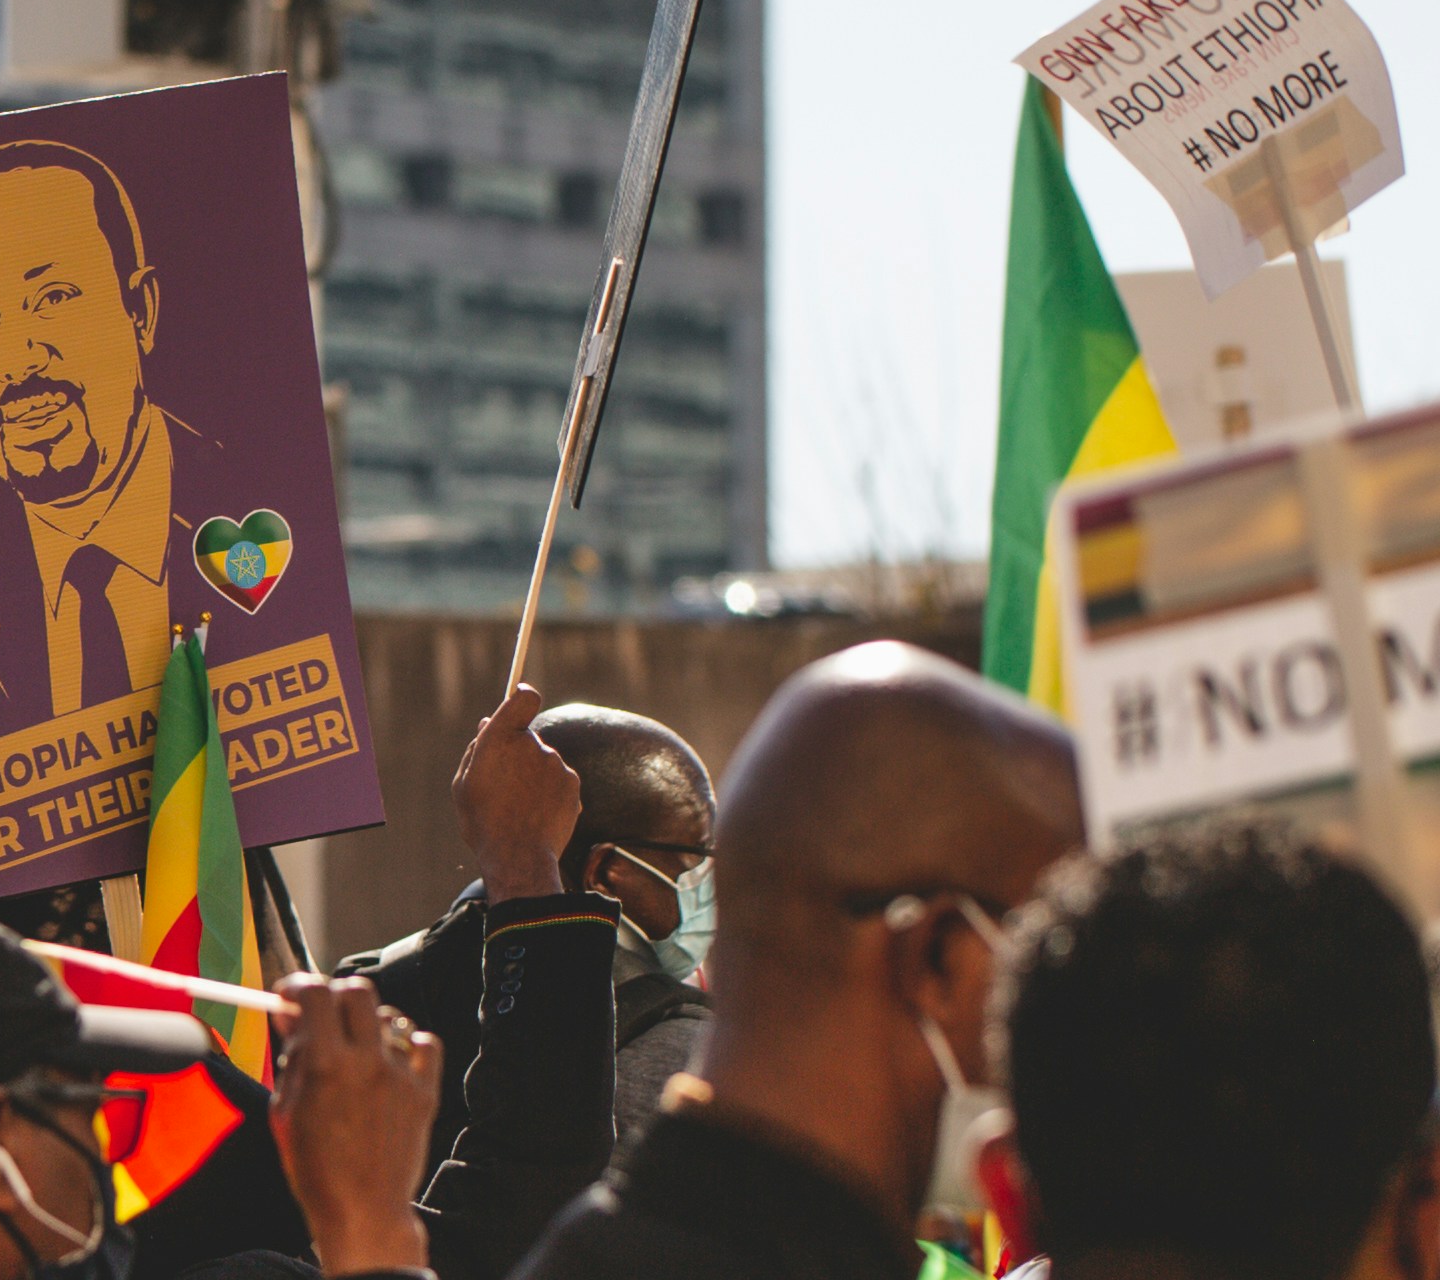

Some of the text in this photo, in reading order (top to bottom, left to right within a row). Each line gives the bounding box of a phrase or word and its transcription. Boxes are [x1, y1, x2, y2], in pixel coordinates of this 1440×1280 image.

[1039, 26, 1115, 83] CNN
[1093, 54, 1200, 139] ABOUT
[1203, 109, 1259, 158] NO
[1252, 51, 1348, 129] MORE
[106, 708, 158, 755] HA
[1193, 641, 1348, 749] NO
[28, 769, 154, 842] THEIR
[228, 709, 351, 781] ADER
